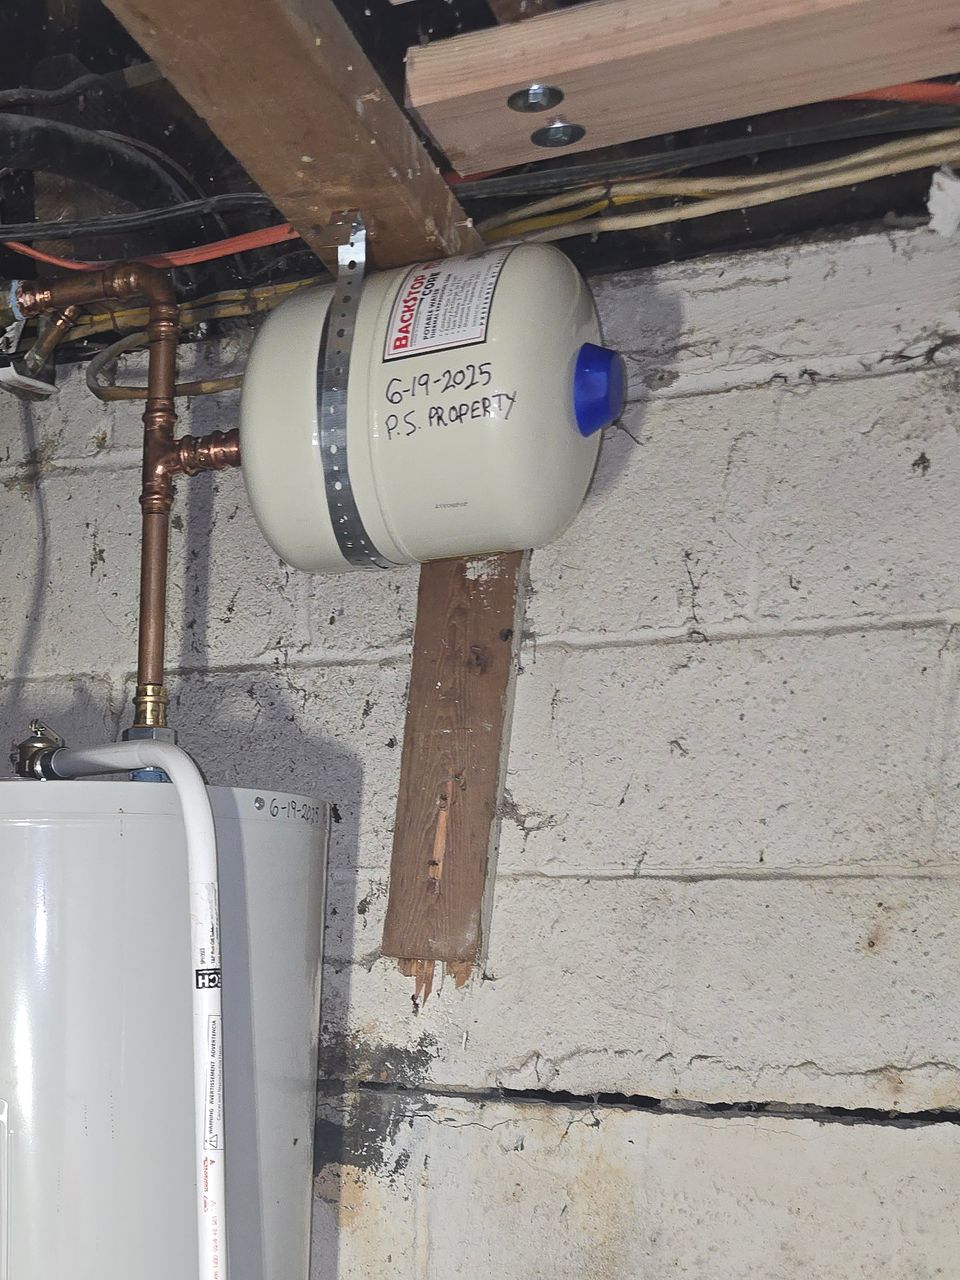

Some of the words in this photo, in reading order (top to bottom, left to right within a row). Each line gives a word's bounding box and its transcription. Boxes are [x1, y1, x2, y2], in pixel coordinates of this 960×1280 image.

[392, 274, 426, 350] BACKSTOP
[423, 310, 433, 340] POTABLE
[386, 362, 493, 404] 6-19-2025
[385, 411, 421, 440] P.S.
[429, 390, 518, 426] PROPERTY
